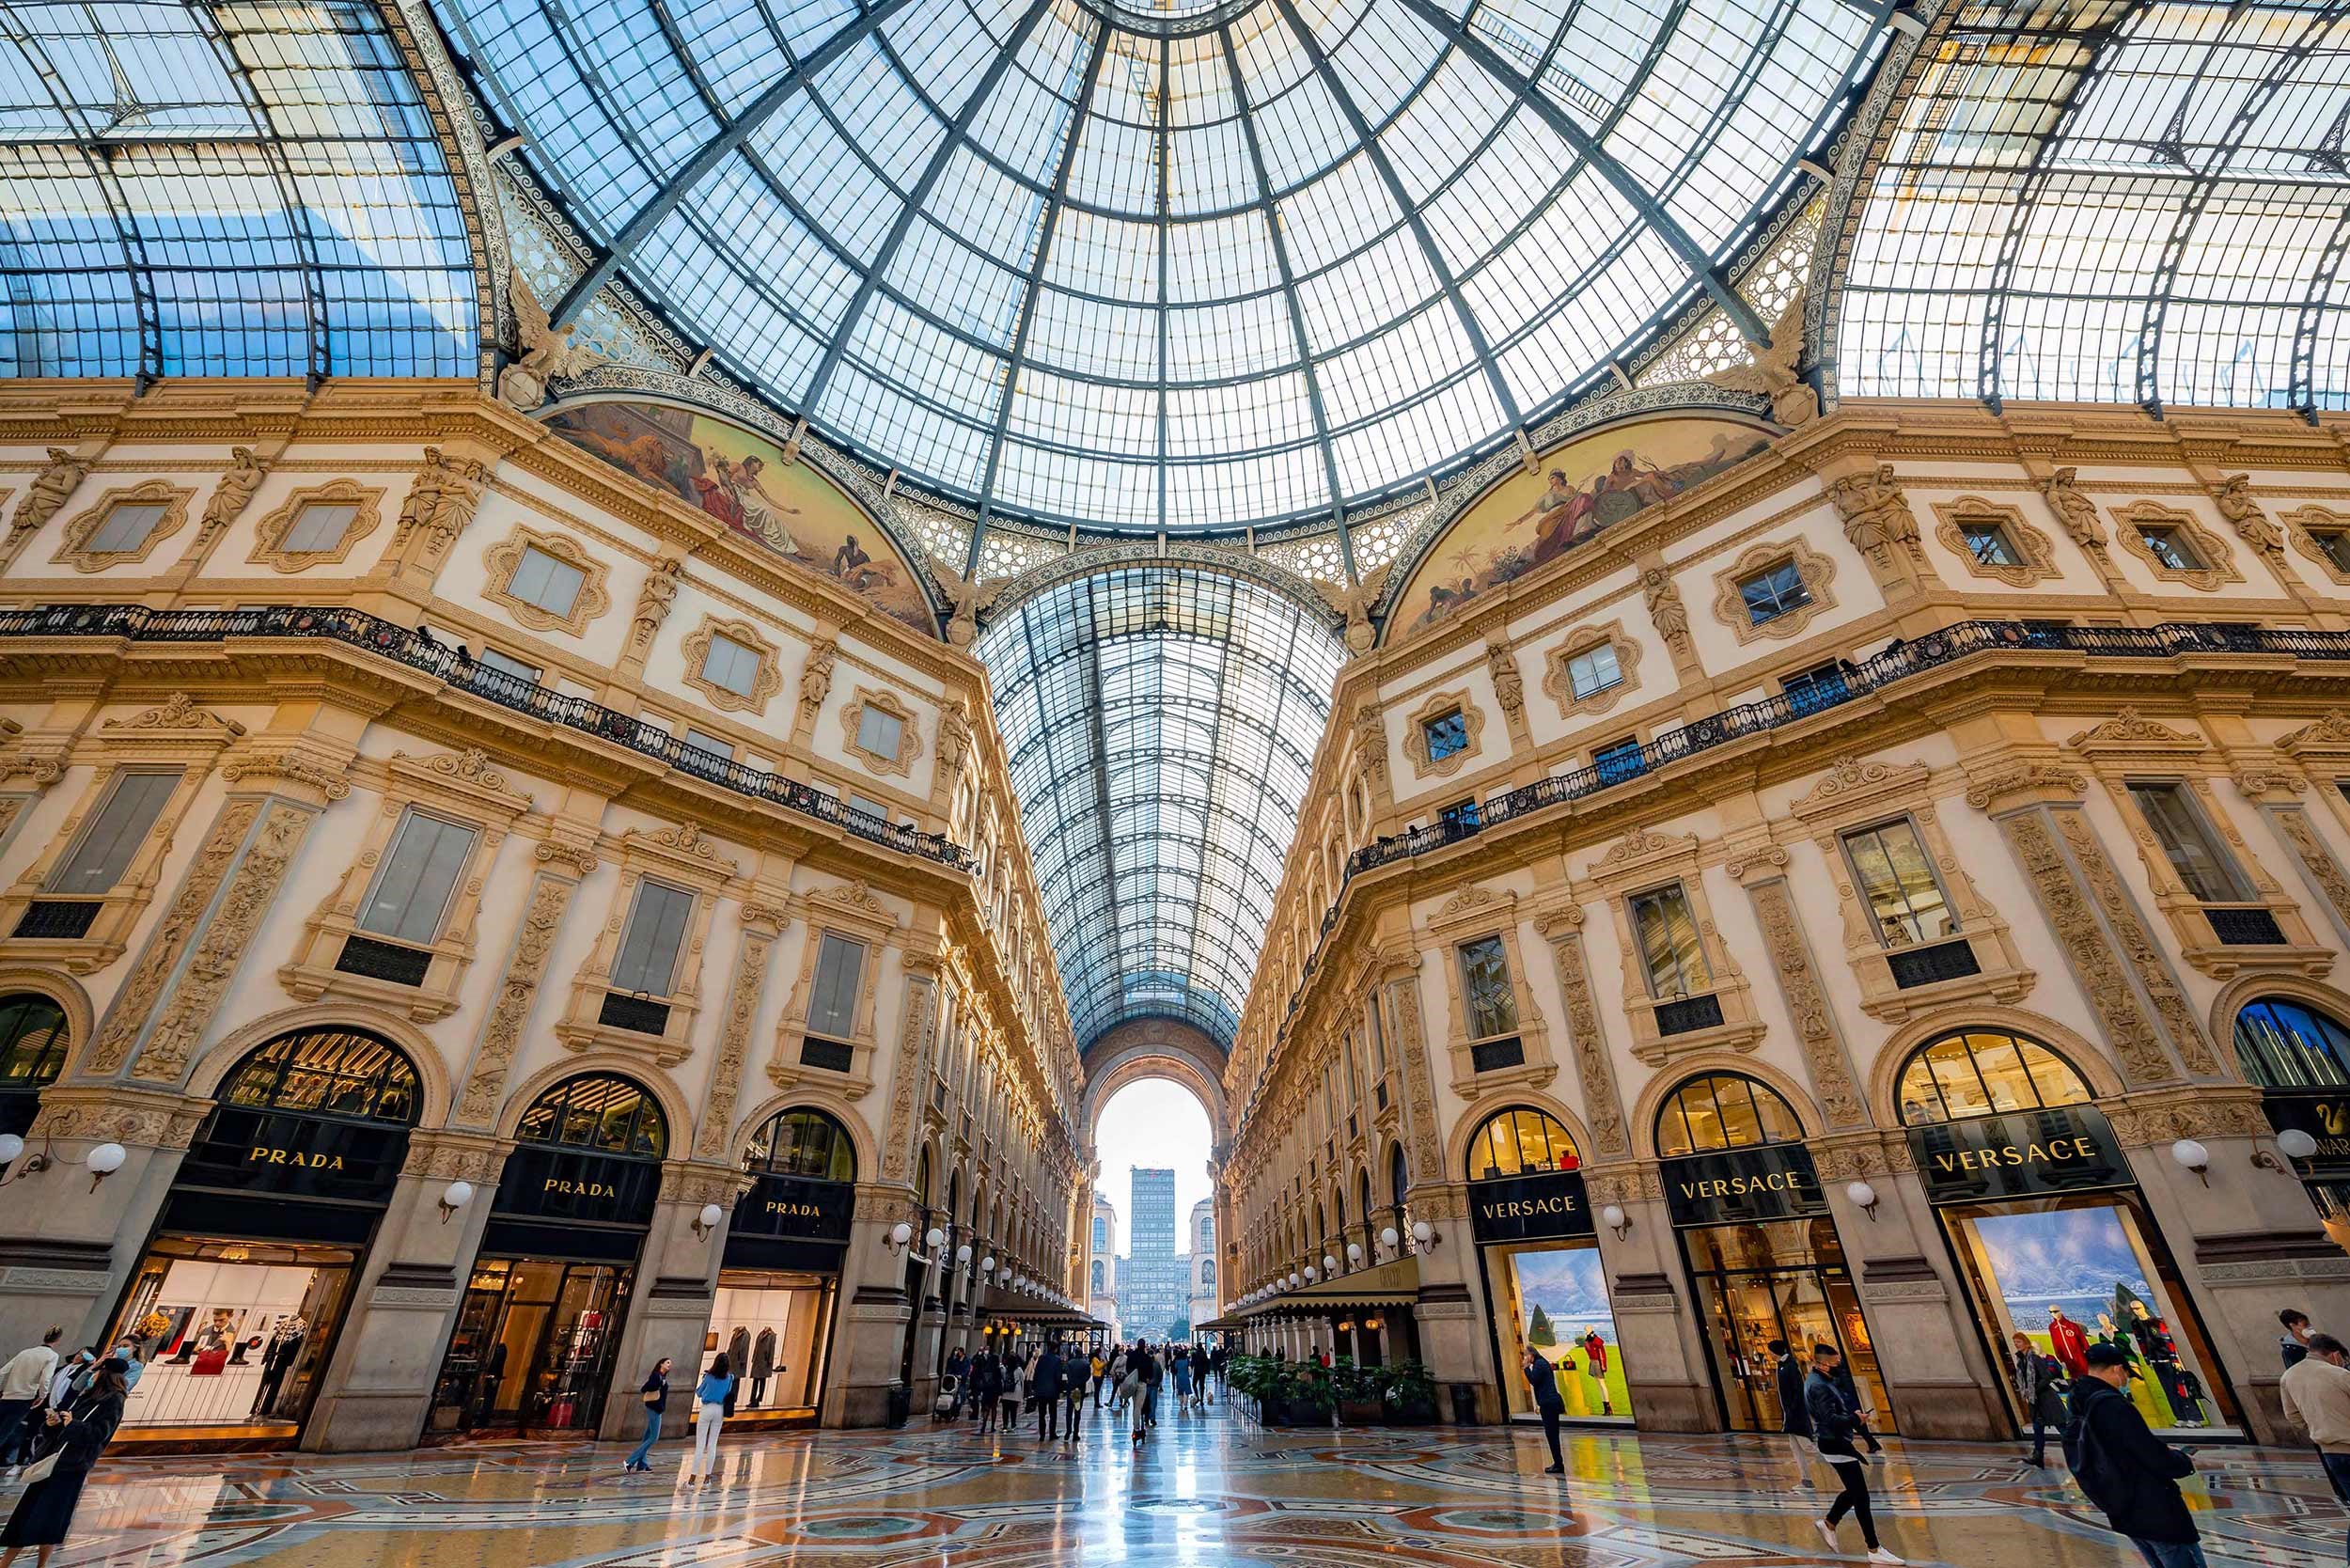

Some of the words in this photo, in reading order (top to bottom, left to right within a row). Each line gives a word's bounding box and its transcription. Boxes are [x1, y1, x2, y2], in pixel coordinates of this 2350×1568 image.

[248, 1146, 344, 1170] PRADA
[1935, 1137, 2096, 1172] VERSACE
[2315, 1137, 2350, 1156] WAR
[543, 1178, 616, 1198] PRADA
[1680, 1171, 1802, 1200] VERSACE
[765, 1201, 821, 1217] PRADA
[1482, 1195, 1576, 1219] VERSACE
